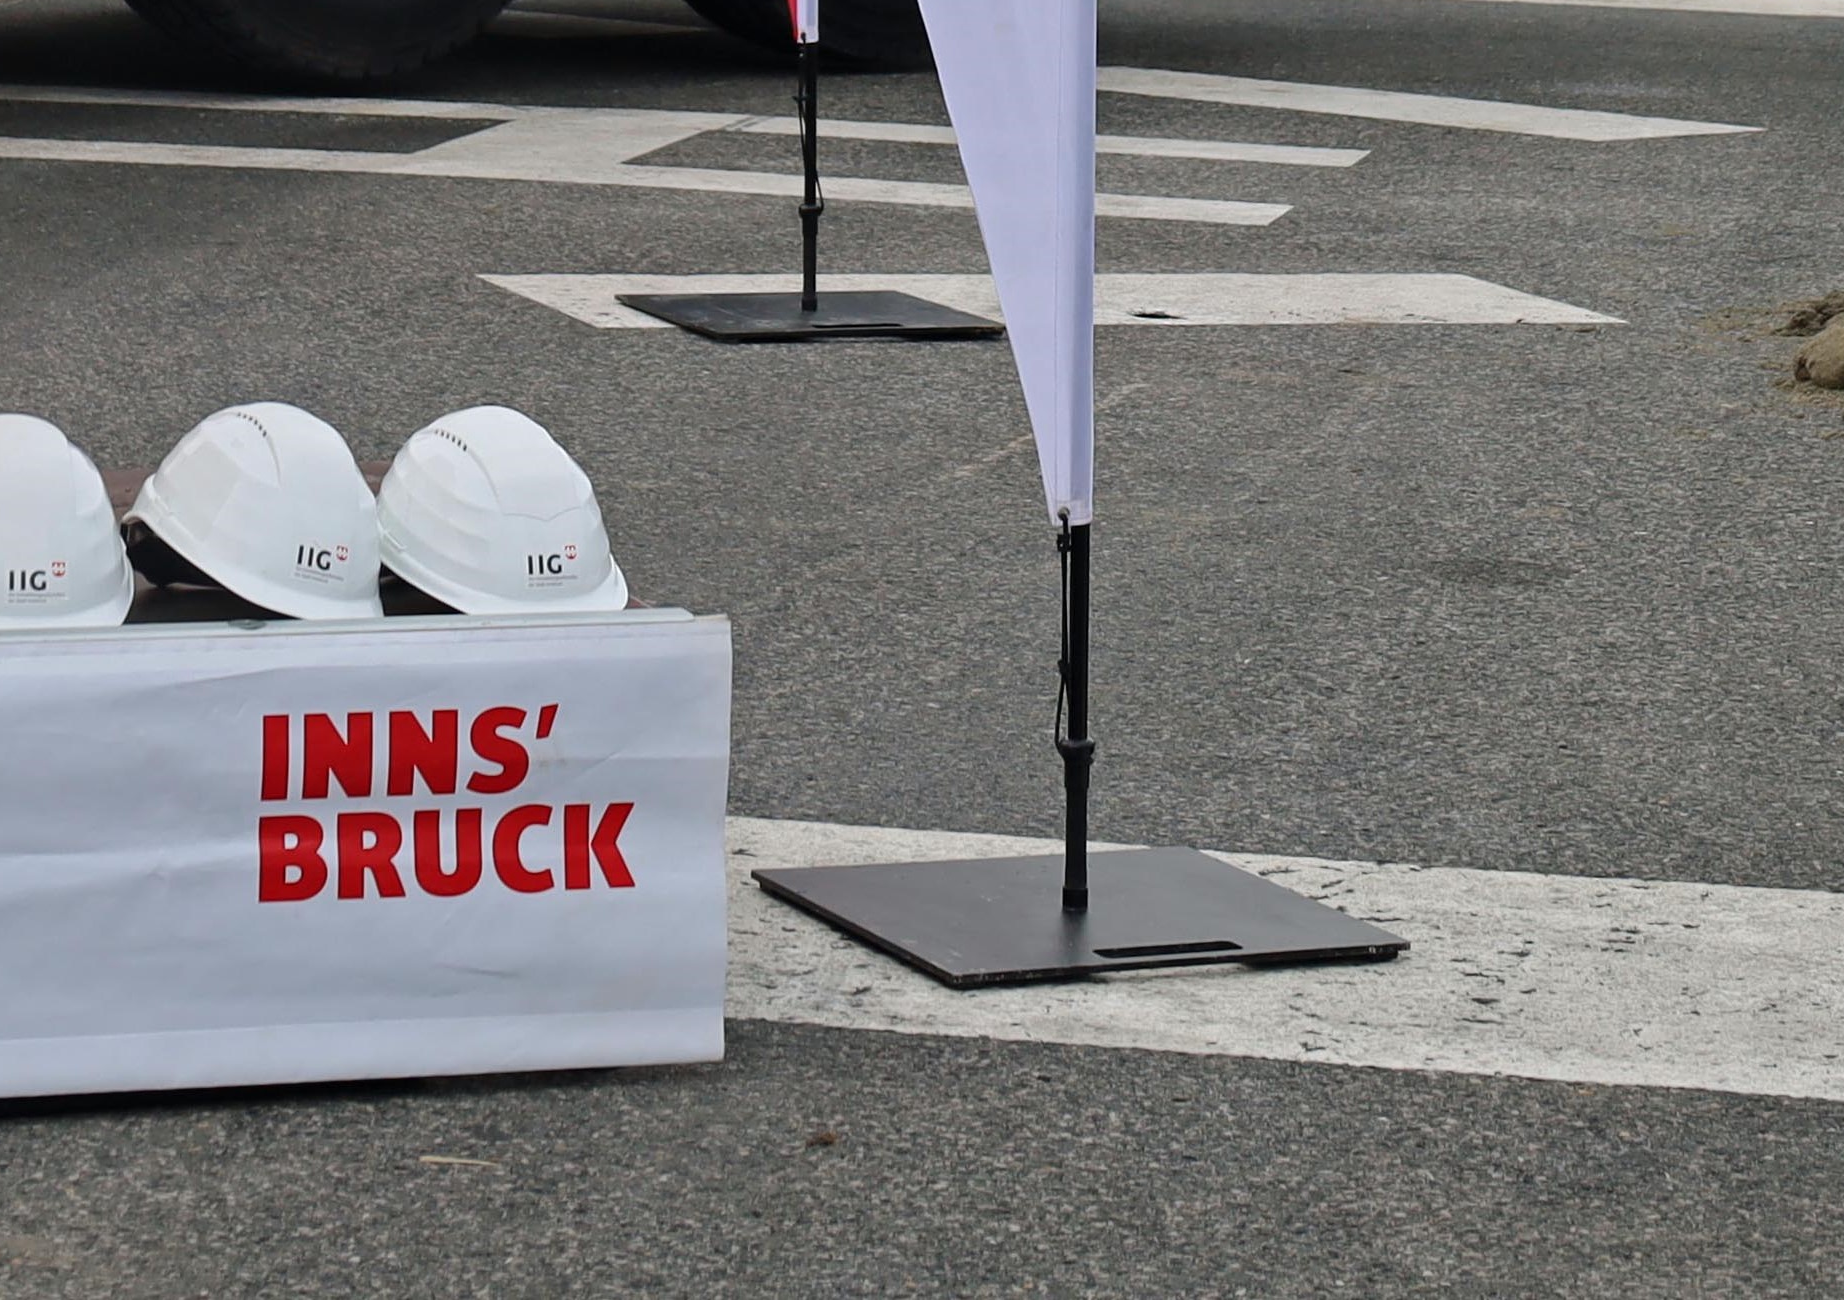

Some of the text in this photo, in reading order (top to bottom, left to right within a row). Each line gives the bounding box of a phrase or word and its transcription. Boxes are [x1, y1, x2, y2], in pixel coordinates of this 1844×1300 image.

[297, 544, 332, 571] IIG
[528, 554, 562, 575] IIG
[9, 570, 47, 591] IIG
[260, 704, 559, 801] INNS'
[259, 802, 636, 903] BRUCK
